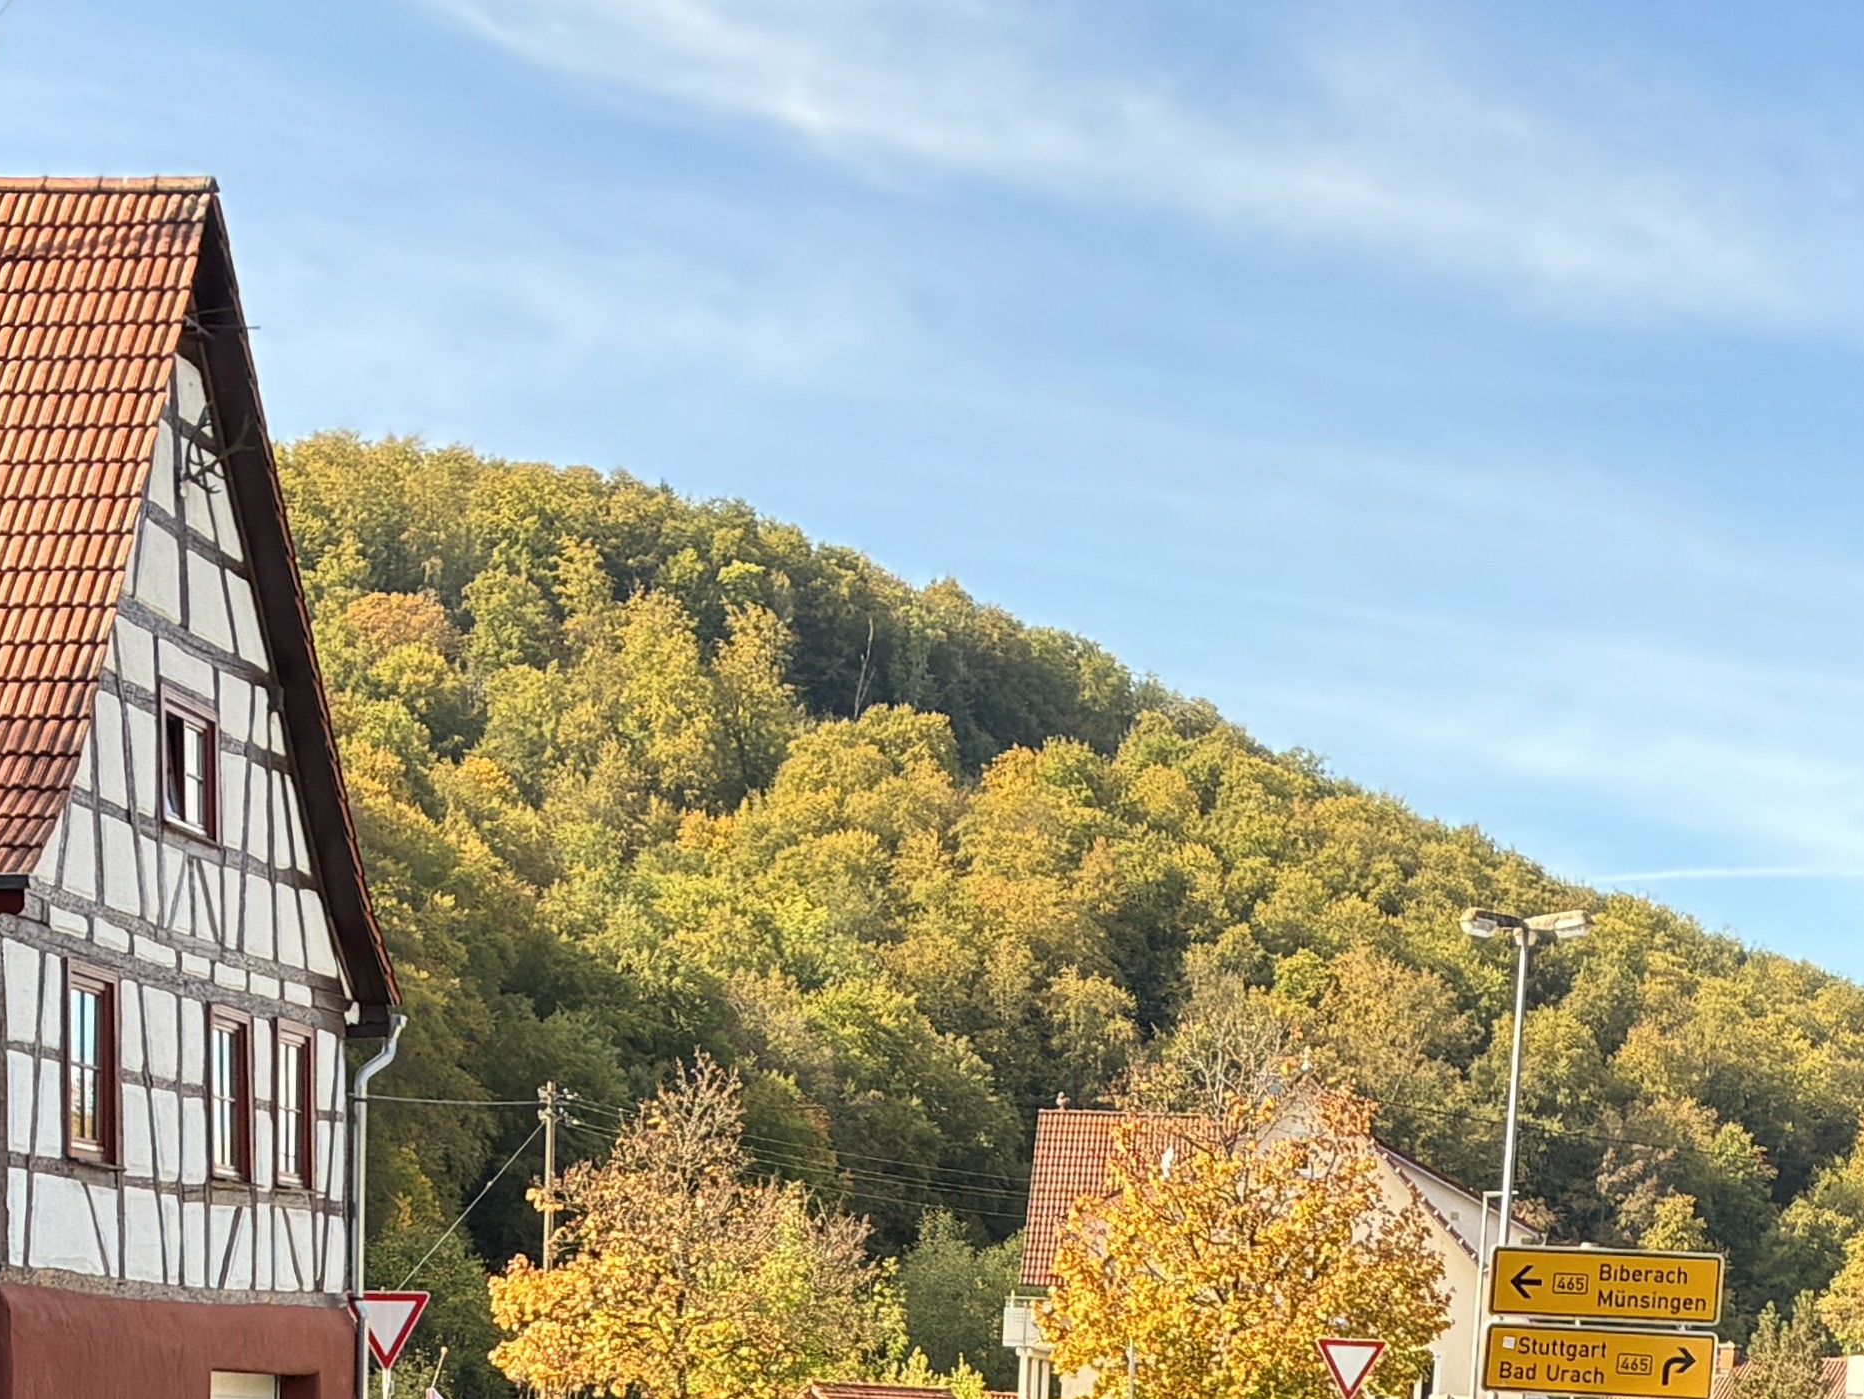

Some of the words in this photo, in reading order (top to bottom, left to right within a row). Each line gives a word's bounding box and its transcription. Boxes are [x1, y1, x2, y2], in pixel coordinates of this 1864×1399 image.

[1556, 1276, 1585, 1292] 465
[1598, 1263, 1688, 1285] Biberach
[1597, 1290, 1707, 1315] Münsingen
[1517, 1336, 1607, 1362] Stuttgart
[1499, 1361, 1537, 1381] Bad
[1546, 1364, 1605, 1385] Urach
[1620, 1356, 1649, 1372] 465
